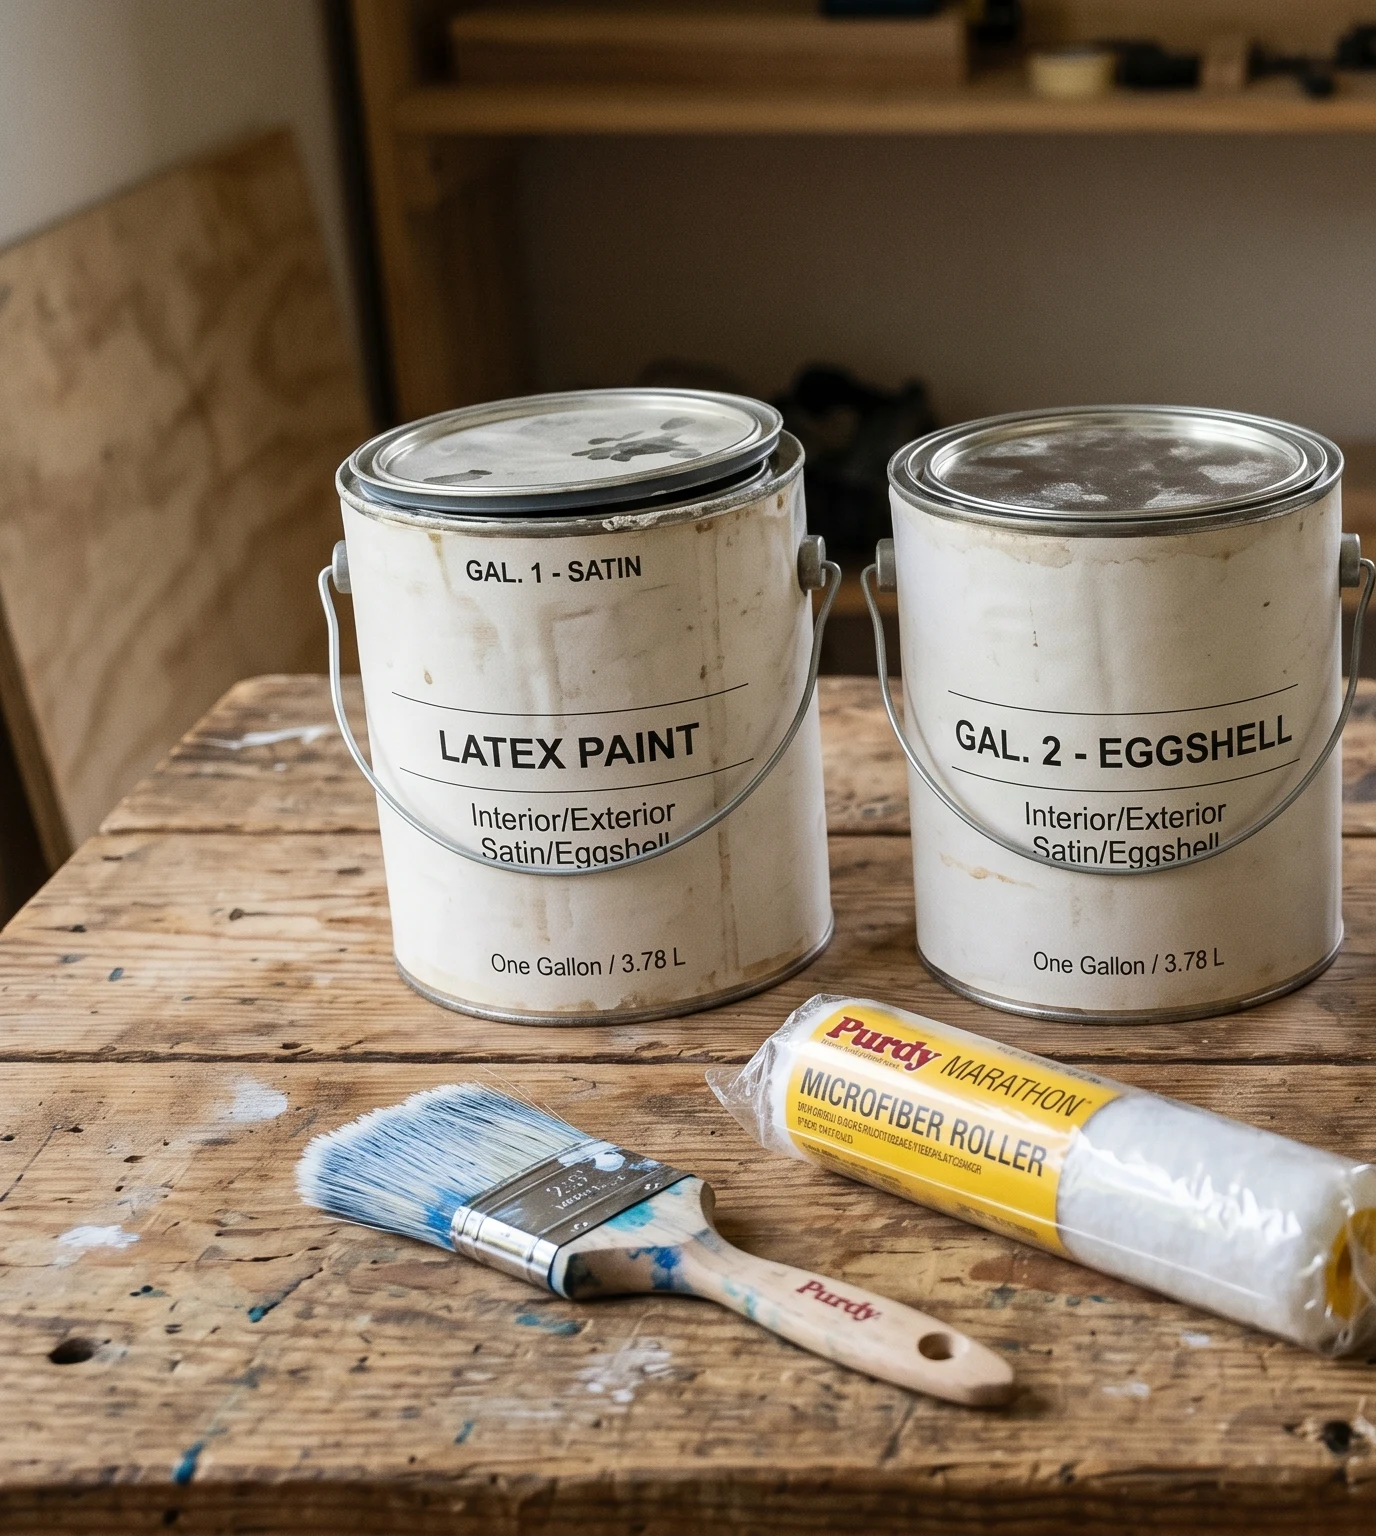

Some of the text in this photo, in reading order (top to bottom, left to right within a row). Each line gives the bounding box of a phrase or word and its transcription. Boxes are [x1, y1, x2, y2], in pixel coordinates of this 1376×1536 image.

[467, 559, 523, 583] GAL.
[531, 562, 542, 583] 1
[568, 555, 642, 583] SATIN
[440, 722, 700, 770] LATEX PAINT
[955, 719, 1030, 763] GAL.
[1042, 735, 1062, 767] 2
[1100, 714, 1293, 768] EGGSHELL
[472, 802, 676, 833] Interior/Exterior
[1026, 801, 1227, 831] Interior/Exterior
[1033, 832, 1219, 869] Satin/Eggshell
[492, 947, 686, 977] One Gallon / 3.78 L
[1033, 948, 1225, 976] One Gallon / 3.78 L
[826, 1016, 942, 1071] Purdy
[940, 1055, 1087, 1117] MARATHON
[800, 1066, 945, 1142] MICROFIBER
[949, 1117, 1047, 1177] ROLLER
[796, 1280, 882, 1321] Purdy
